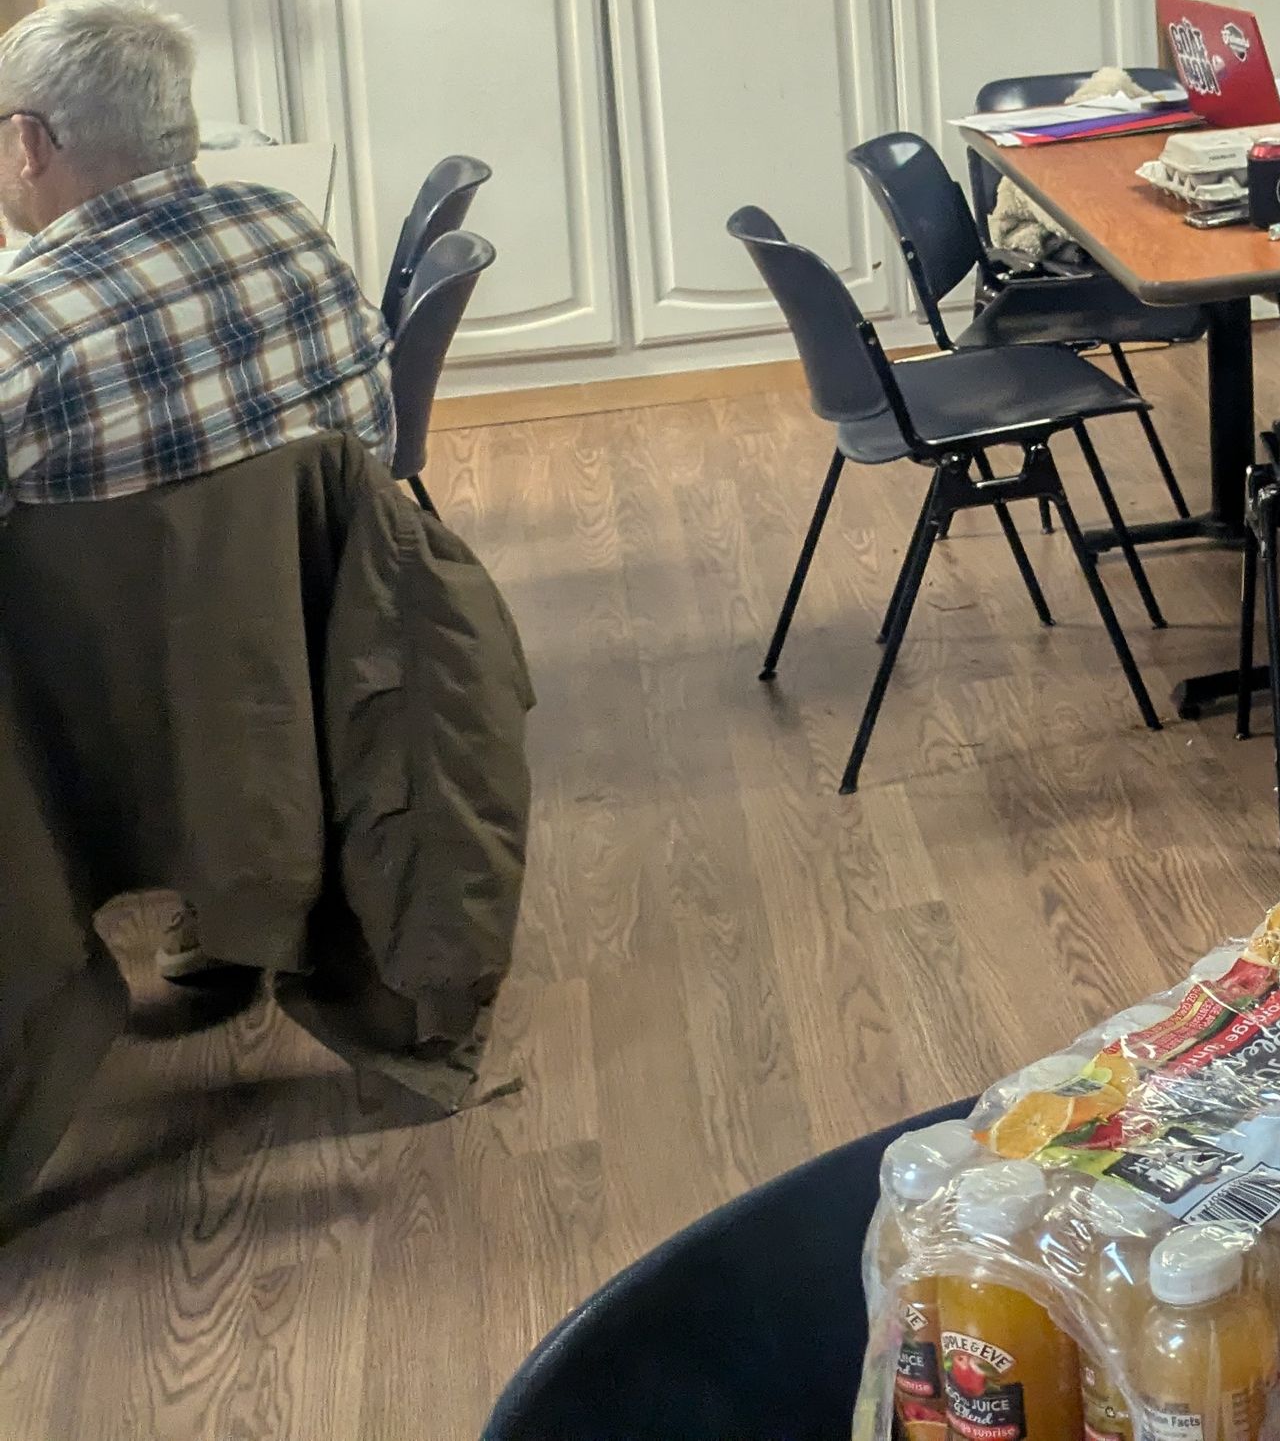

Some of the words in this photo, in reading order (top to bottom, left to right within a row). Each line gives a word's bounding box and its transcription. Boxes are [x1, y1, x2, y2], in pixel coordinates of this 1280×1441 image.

[980, 1345, 1009, 1370] EVE
[971, 1399, 1010, 1412] JUICE
[1171, 1416, 1201, 1428] Facts
